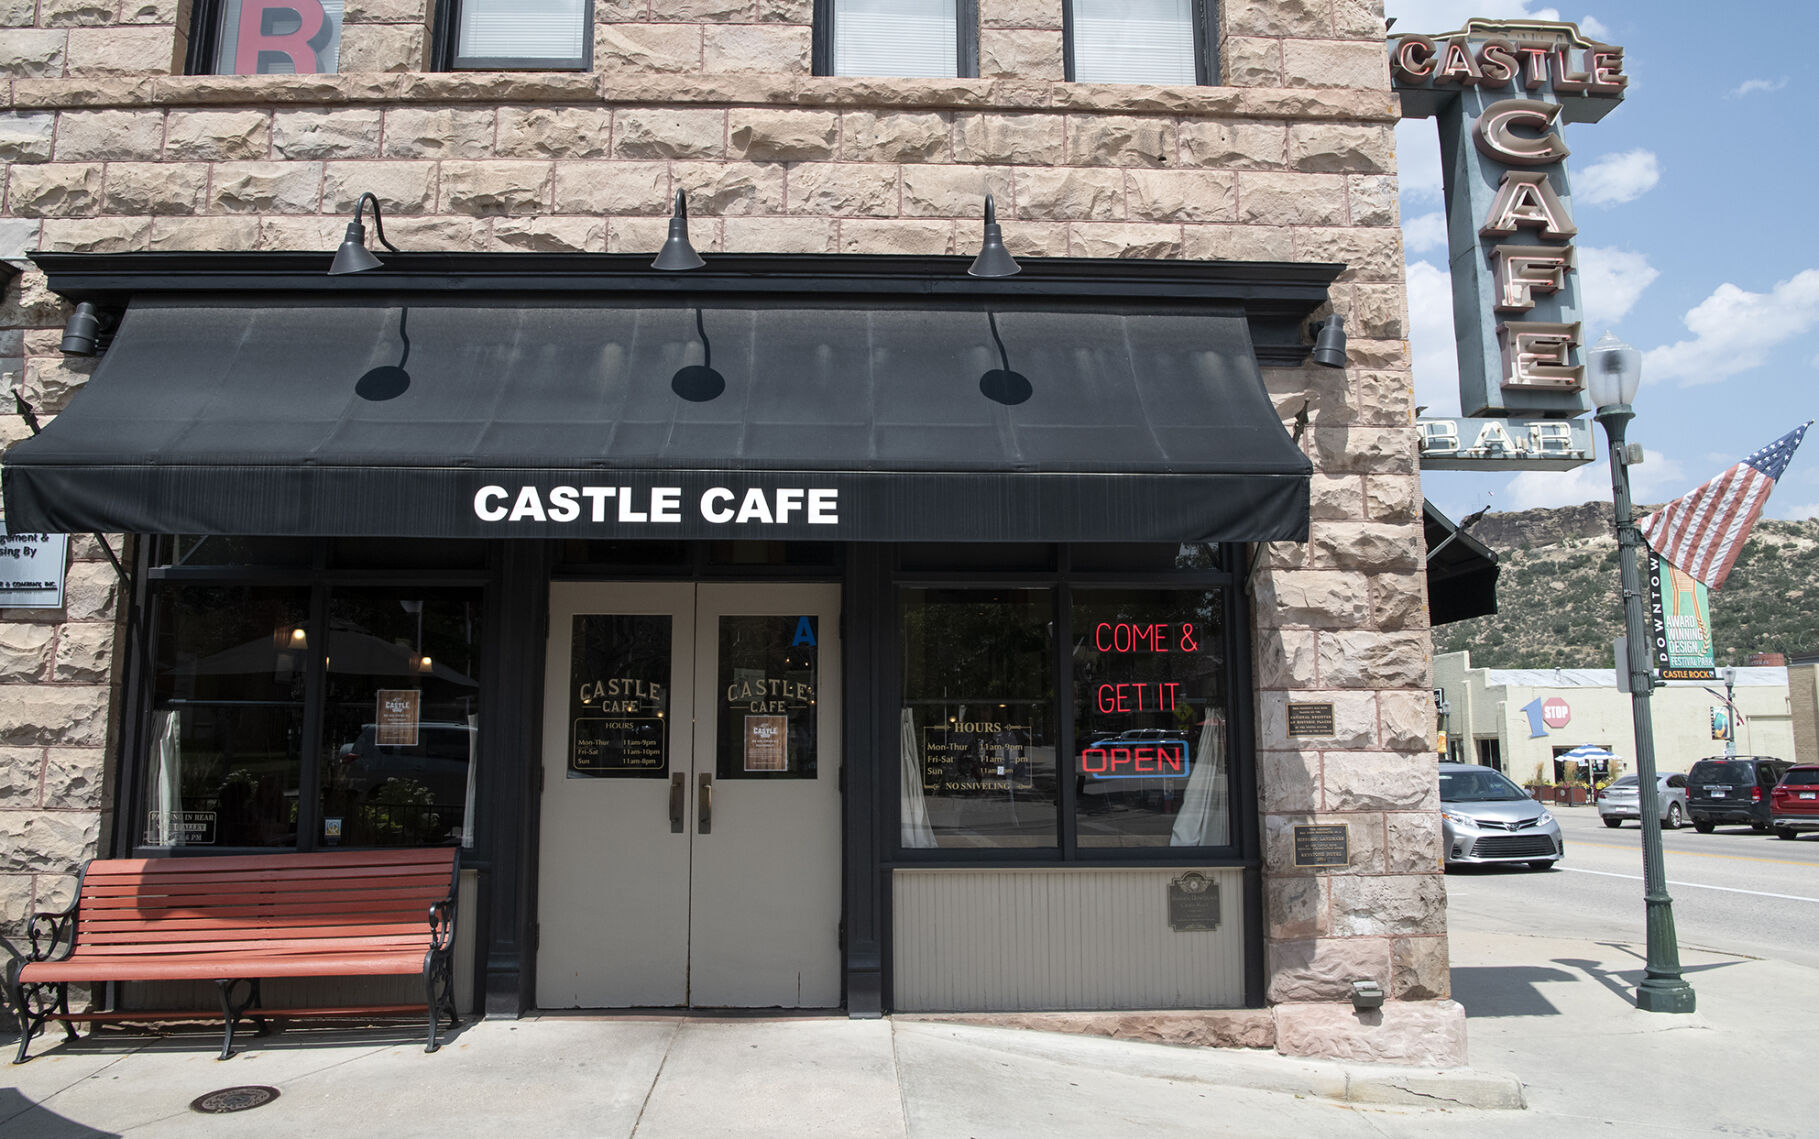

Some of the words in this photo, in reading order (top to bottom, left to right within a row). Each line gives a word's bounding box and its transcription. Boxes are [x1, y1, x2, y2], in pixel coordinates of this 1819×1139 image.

[1390, 34, 1628, 95] CASTLE
[1473, 99, 1587, 393] CAFE
[474, 485, 682, 523] CASTLE
[700, 487, 839, 525] CAFE
[23, 546, 37, 558] By
[1649, 556, 1669, 662] DOWNTOW
[1666, 615, 1695, 628] AWARD
[792, 615, 817, 647] A
[1096, 622, 1168, 653] COME
[1180, 623, 1198, 653] &
[1667, 628, 1704, 641] WINNING
[1669, 641, 1698, 653] DESIGN
[1671, 656, 1697, 666] FESTIVAL
[1697, 656, 1714, 666] PARK
[1663, 670, 1688, 679] CASTLE
[1689, 670, 1708, 679] ROCK
[580, 678, 660, 701] CASTLE
[727, 678, 808, 702] CASTLE
[1098, 683, 1147, 714] GET
[1159, 682, 1180, 712] IT
[602, 700, 639, 713] CAFE
[750, 700, 786, 713] CAFE
[1544, 705, 1568, 719] STOP
[605, 722, 634, 730] HOURS
[753, 727, 778, 735] CASTLE
[954, 722, 1002, 733] HOURS
[927, 742, 968, 751] Mon-Thur
[980, 743, 1023, 753] 11am-9pm
[927, 755, 954, 764] Fri-Sat
[1081, 747, 1180, 772] OPEN
[927, 767, 943, 775] Sun
[945, 782, 959, 790] NO
[960, 782, 1011, 791] SNIVELING
